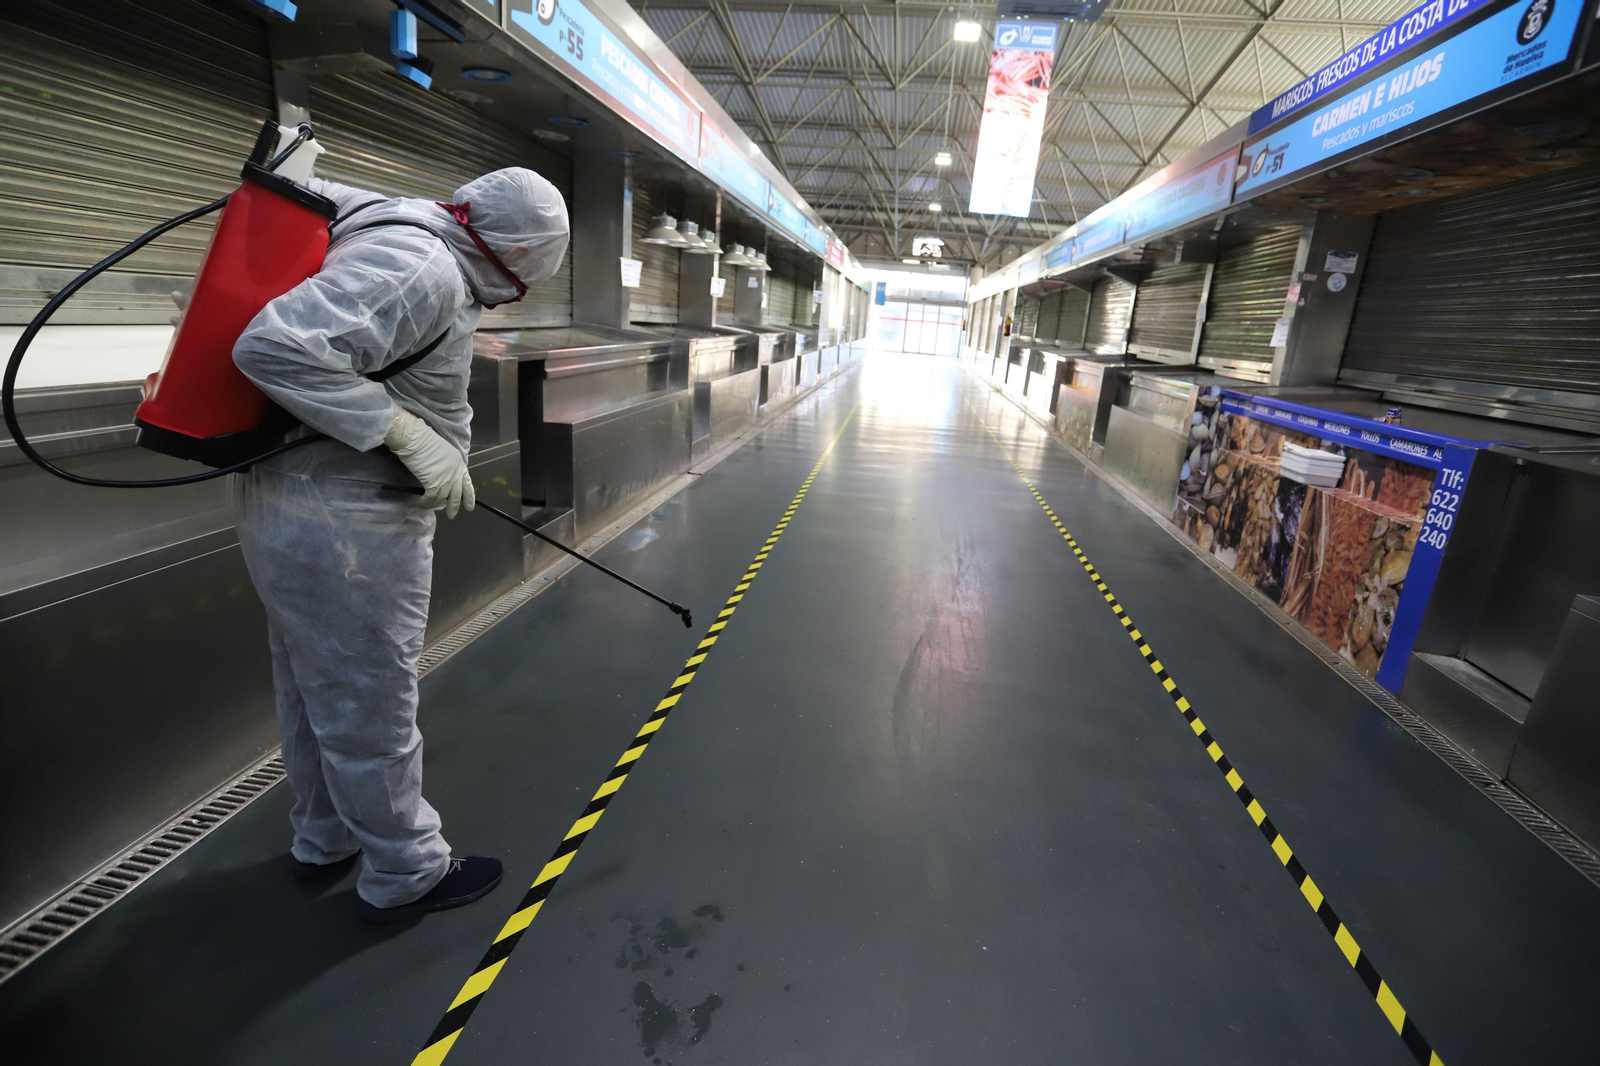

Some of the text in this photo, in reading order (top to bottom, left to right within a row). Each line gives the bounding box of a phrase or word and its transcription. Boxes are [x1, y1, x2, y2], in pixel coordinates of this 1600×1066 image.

[601, 33, 649, 94] PESCADOS
[1271, 77, 1315, 119] MARISCOS
[1316, 48, 1361, 93] FRESCOS
[1360, 37, 1380, 68] DE
[1379, 26, 1397, 56] LA
[1398, 0, 1444, 45] COSTA
[1503, 51, 1544, 74] de Huelva
[1506, 40, 1547, 64] Mercados
[1312, 52, 1445, 138] CARMEN E HIJOS
[1321, 101, 1415, 152] Pescados y mariscos
[1361, 431, 1380, 443] TOLLOS
[1390, 438, 1428, 457] CAMARONES
[1441, 468, 1464, 490] Tlf:
[1432, 489, 1459, 512] 622
[1426, 508, 1453, 531] 640
[1420, 527, 1447, 550] 240
